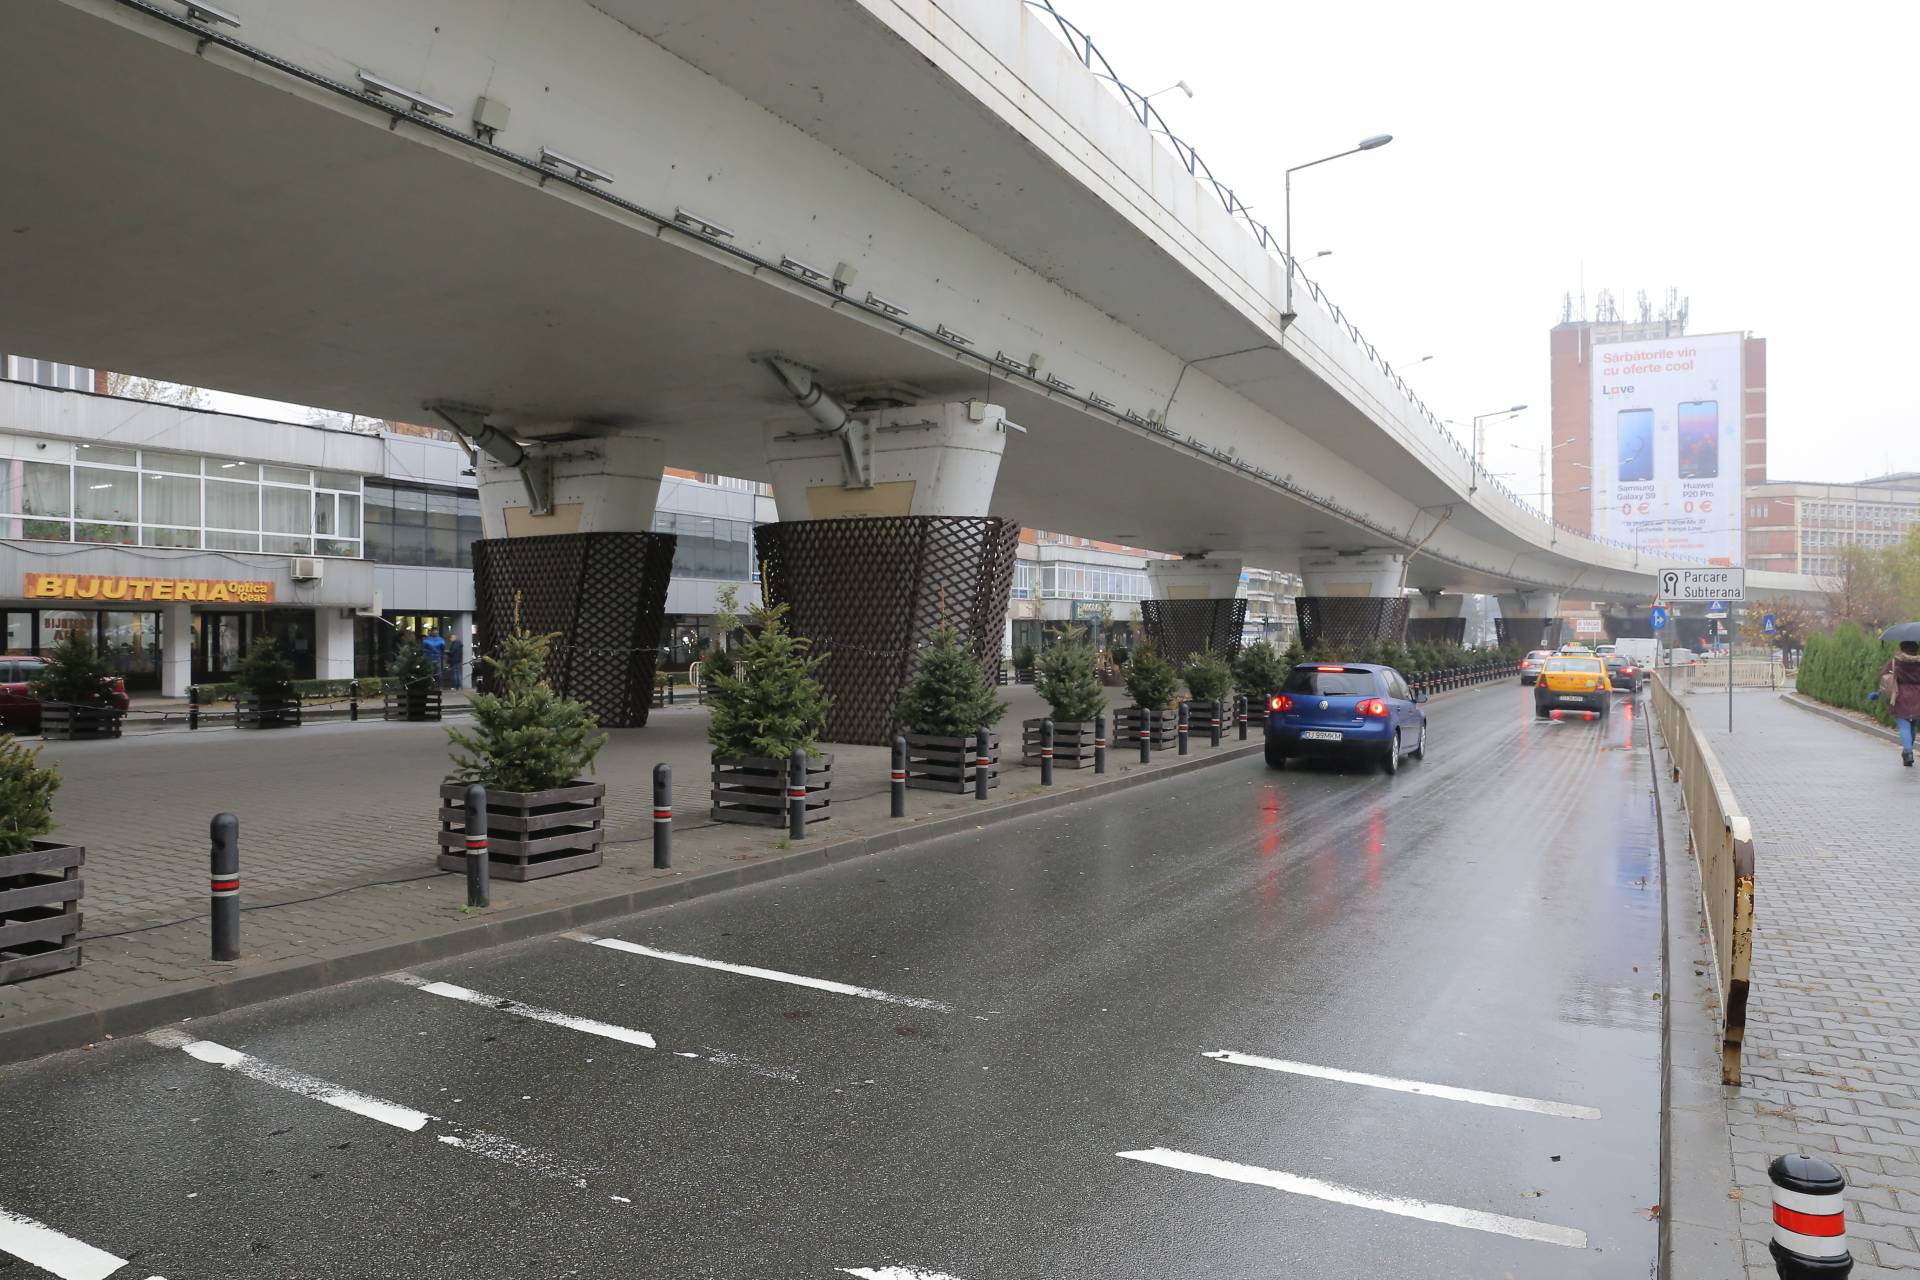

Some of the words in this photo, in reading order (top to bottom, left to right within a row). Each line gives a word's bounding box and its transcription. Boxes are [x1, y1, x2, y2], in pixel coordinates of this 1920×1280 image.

[1677, 348, 1697, 357] vin
[1603, 367, 1619, 376] cu
[1623, 364, 1661, 374] oferte
[1665, 359, 1694, 371] cool
[1602, 385, 1635, 395] Love
[1617, 485, 1655, 493] Samsung
[1683, 482, 1714, 490] Huawei
[1684, 572, 1728, 583] Parcare
[35, 576, 229, 601] BIJUTERIA
[229, 582, 268, 593] Optica
[239, 591, 266, 602] Ceas
